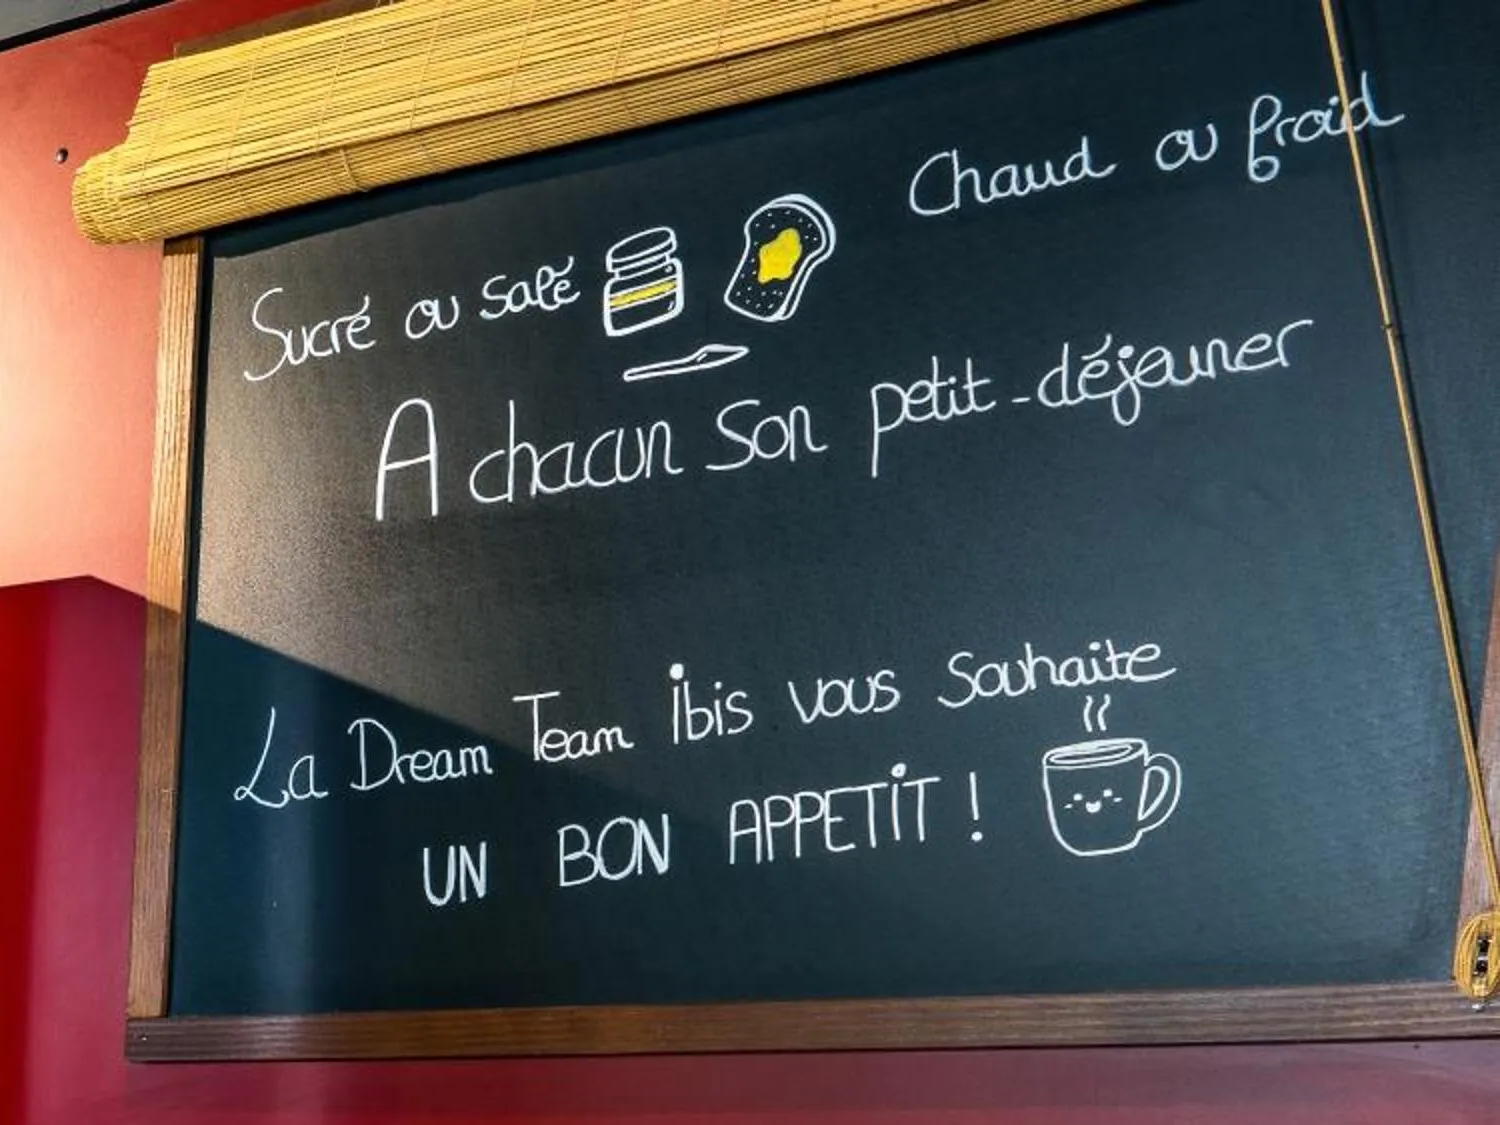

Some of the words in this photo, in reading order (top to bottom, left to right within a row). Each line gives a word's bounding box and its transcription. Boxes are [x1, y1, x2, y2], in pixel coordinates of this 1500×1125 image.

[909, 135, 1118, 217] Chaud
[1155, 122, 1219, 172] ou
[1246, 69, 1406, 183] froid
[243, 286, 377, 382] Sucré
[404, 294, 461, 340] ou
[375, 396, 439, 522] A
[468, 399, 684, 504] chacun
[233, 705, 329, 809] La
[347, 717, 494, 790] Dream
[511, 690, 636, 762] Team
[787, 668, 901, 724] vous
[422, 840, 488, 907] UN
[556, 812, 670, 888] BON
